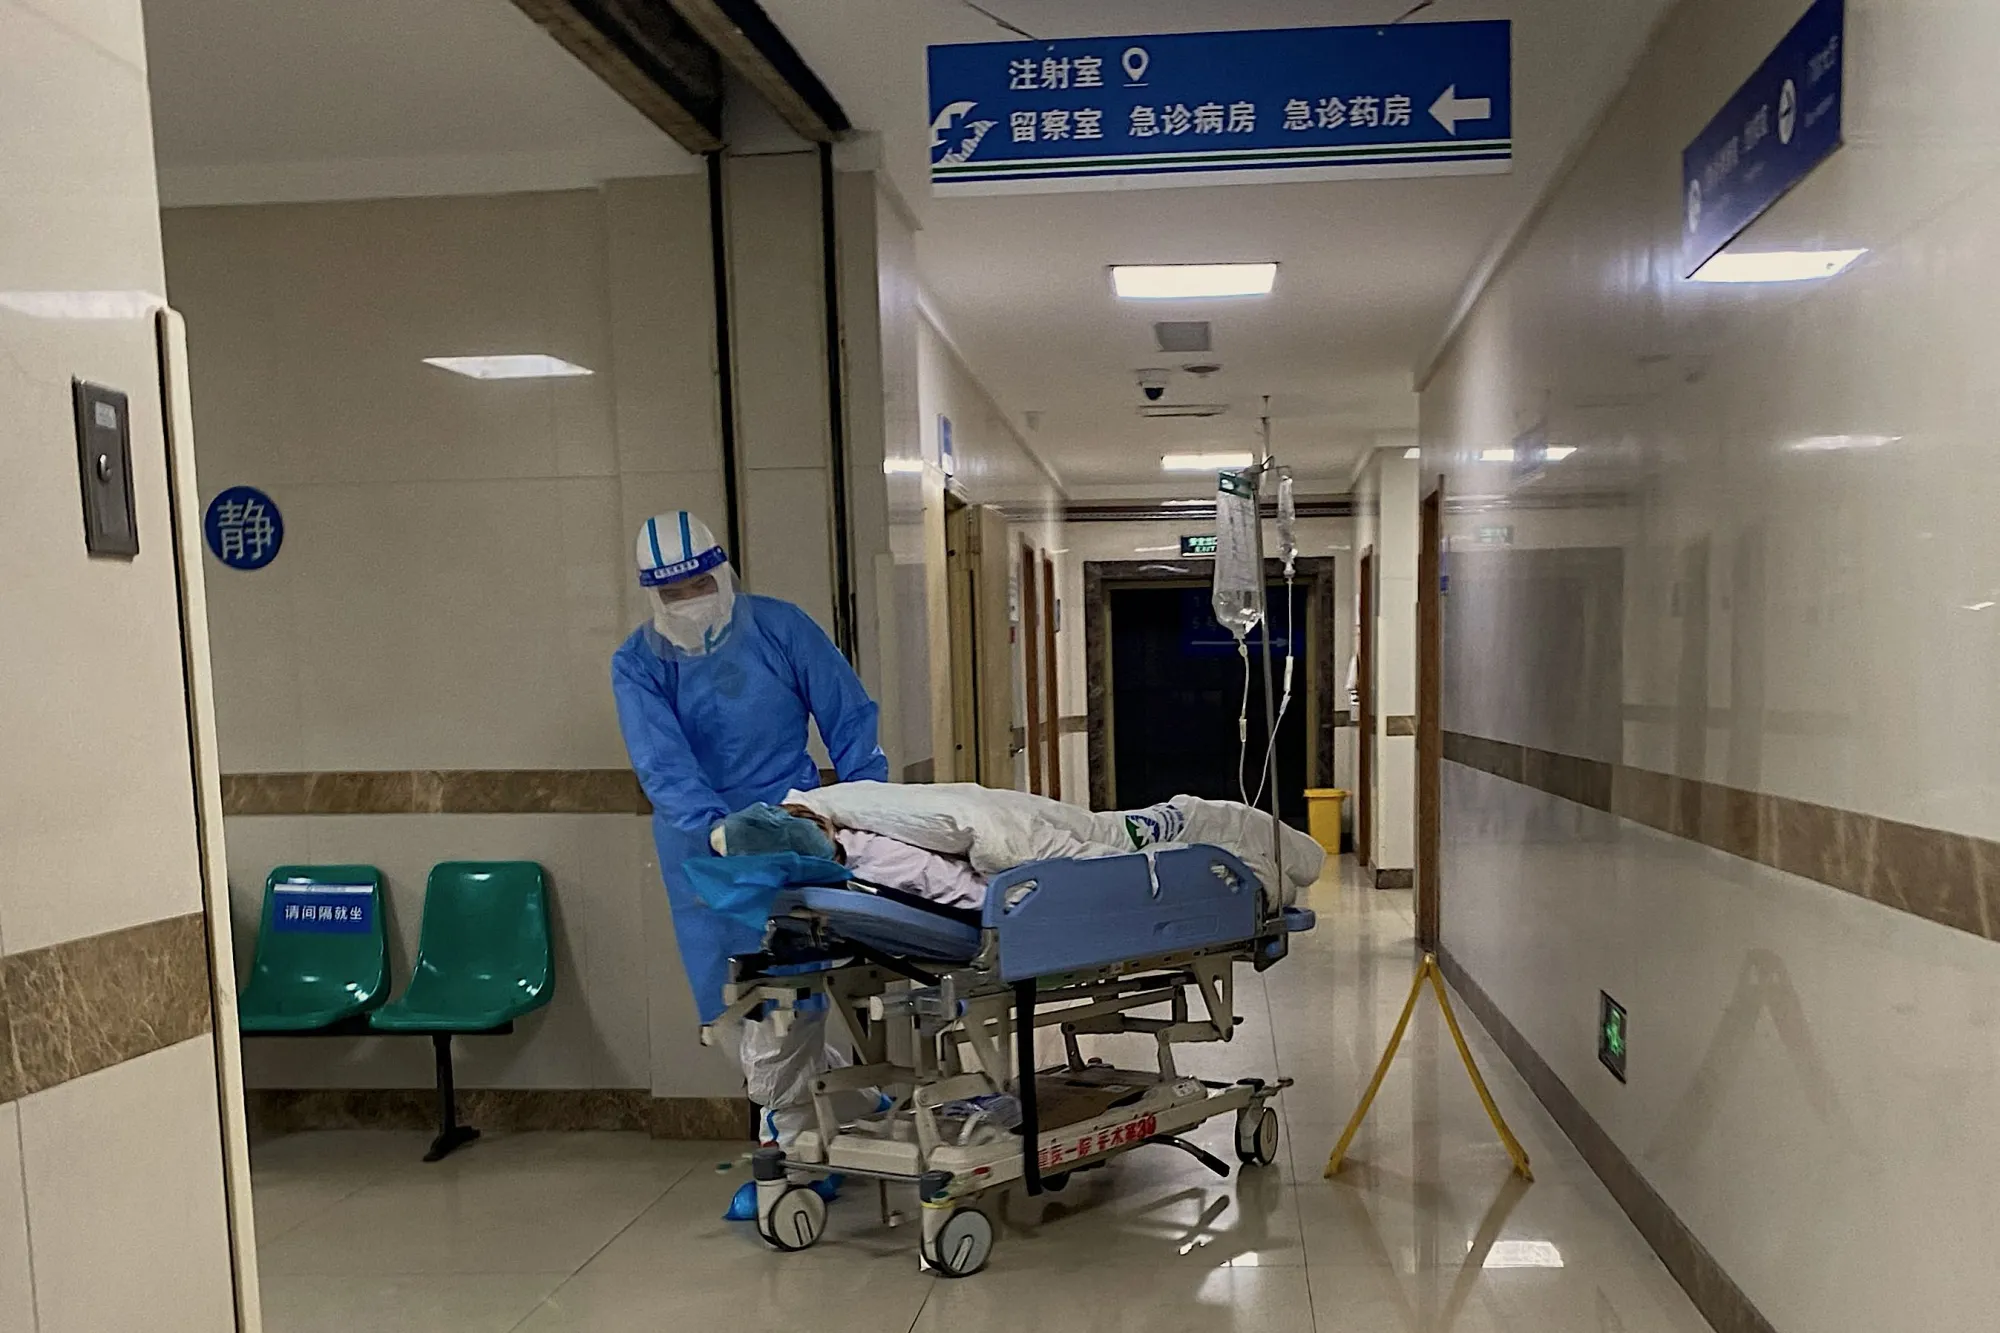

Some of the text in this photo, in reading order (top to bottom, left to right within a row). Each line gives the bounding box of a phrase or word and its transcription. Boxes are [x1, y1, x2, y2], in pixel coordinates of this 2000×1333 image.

[1009, 56, 1104, 90] 注射室
[1010, 94, 1412, 143] 留察室 急诊病房 急诊药房
[216, 498, 275, 561] 静
[285, 904, 363, 921] 请间隔就坐
